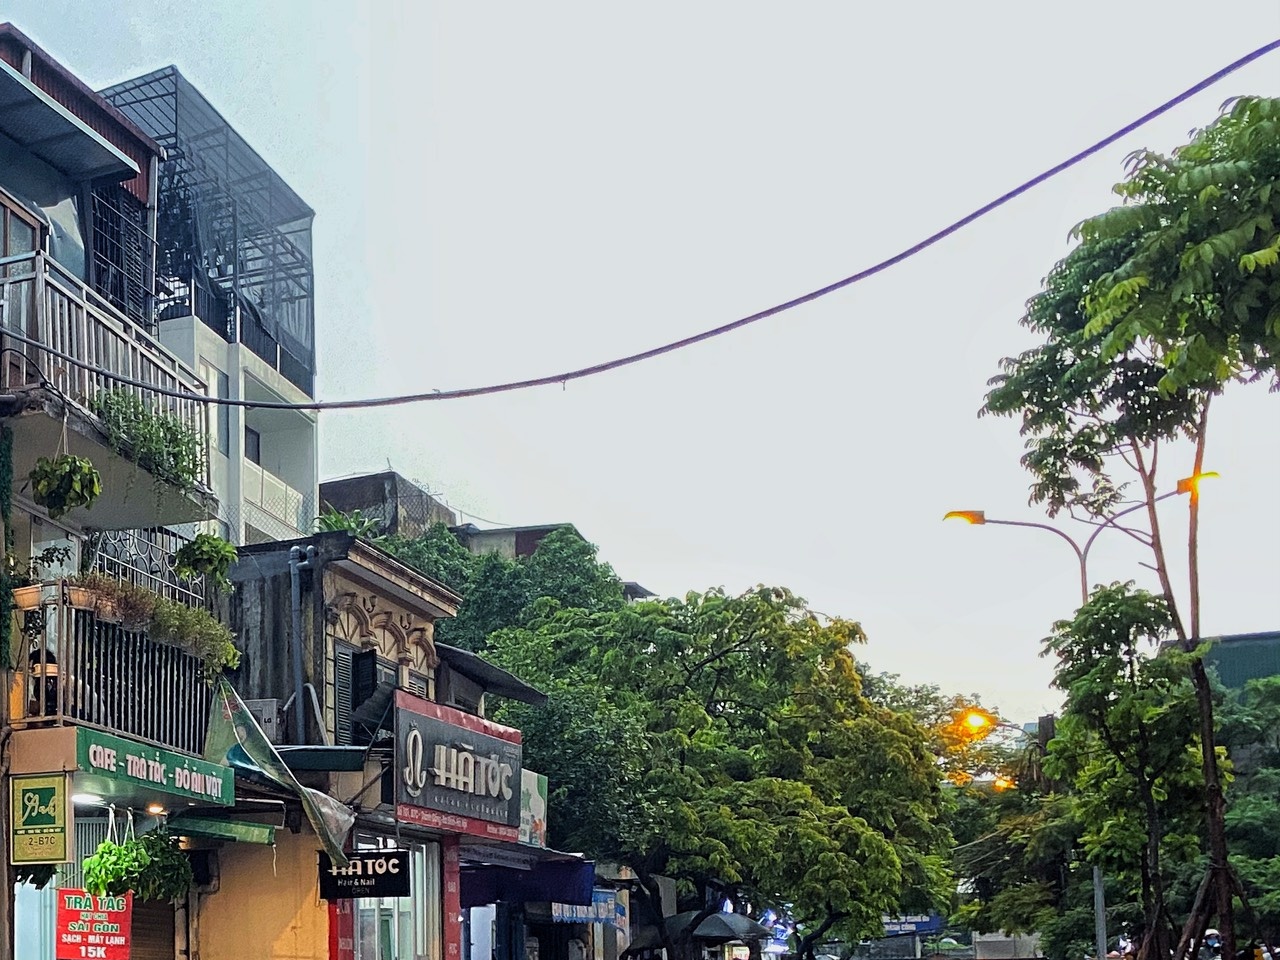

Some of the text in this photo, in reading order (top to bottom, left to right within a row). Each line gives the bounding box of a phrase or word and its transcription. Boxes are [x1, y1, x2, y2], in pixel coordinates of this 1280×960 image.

[88, 744, 116, 772] CAFE
[126, 752, 146, 780] TRÀ
[175, 760, 190, 790] ĐỒ
[475, 754, 512, 800] TÓC
[364, 857, 400, 874] TÓC
[360, 878, 375, 886] Nail
[64, 892, 93, 910] TRÀ
[68, 920, 120, 933] SÀI GÒN
[62, 934, 81, 944] SẠCH
[79, 946, 106, 958] 15K
